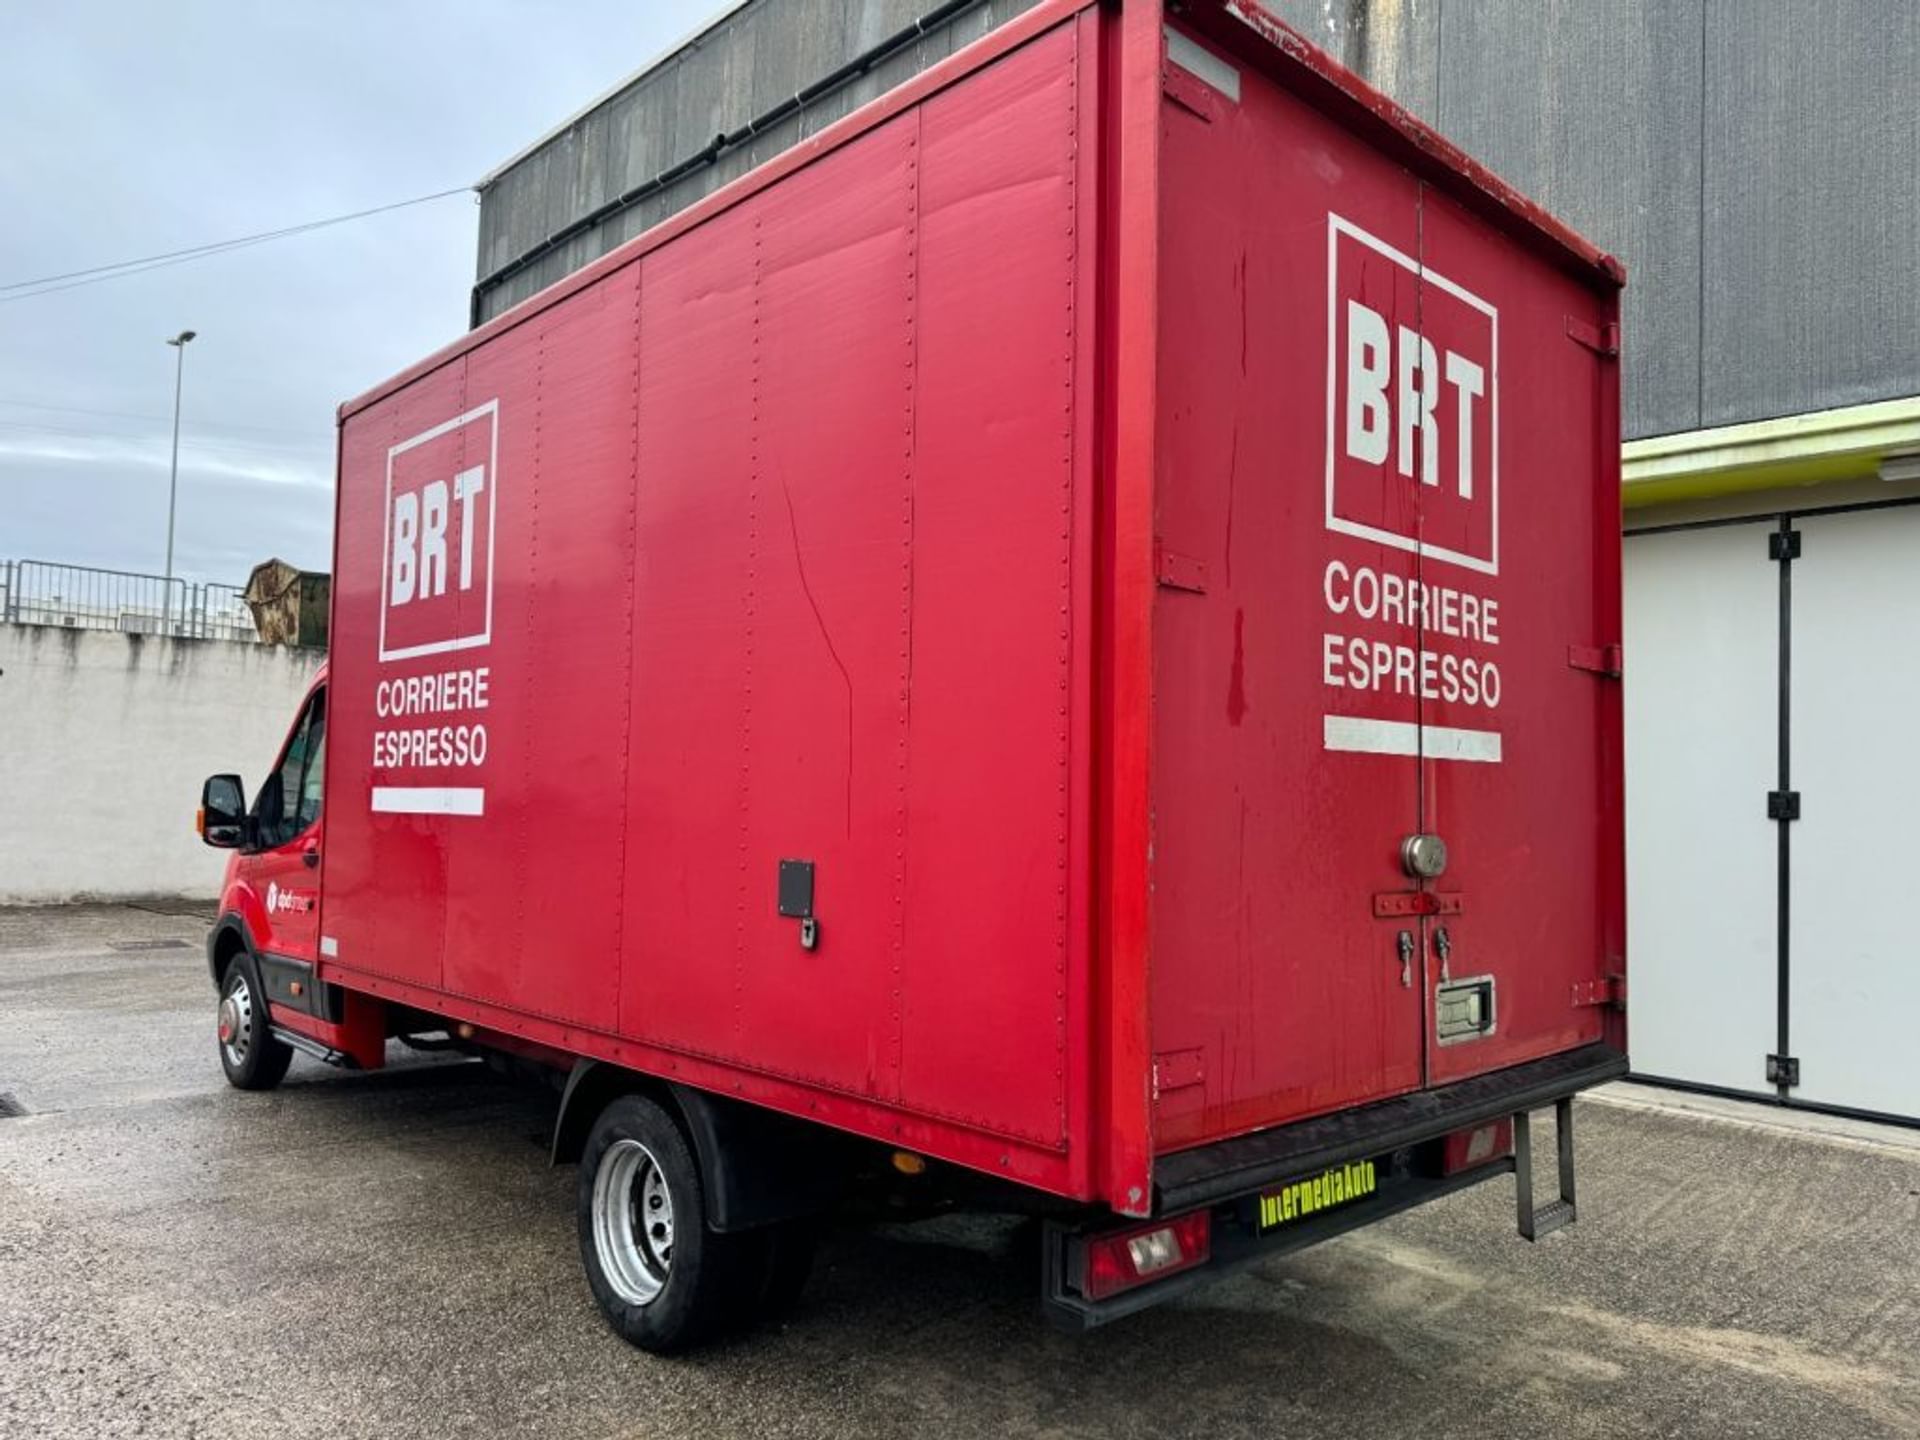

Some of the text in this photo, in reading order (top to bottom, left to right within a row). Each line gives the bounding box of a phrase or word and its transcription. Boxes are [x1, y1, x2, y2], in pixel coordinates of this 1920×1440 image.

[1348, 300, 1484, 499] BRT
[391, 465, 484, 606] BRT
[1324, 561, 1499, 643] CORRIERE
[377, 669, 488, 717] CORRIERE
[1324, 634, 1500, 707] ESPRESSO
[374, 725, 486, 767] ESPRESSO
[1260, 1161, 1375, 1227] IntermediaAuto
